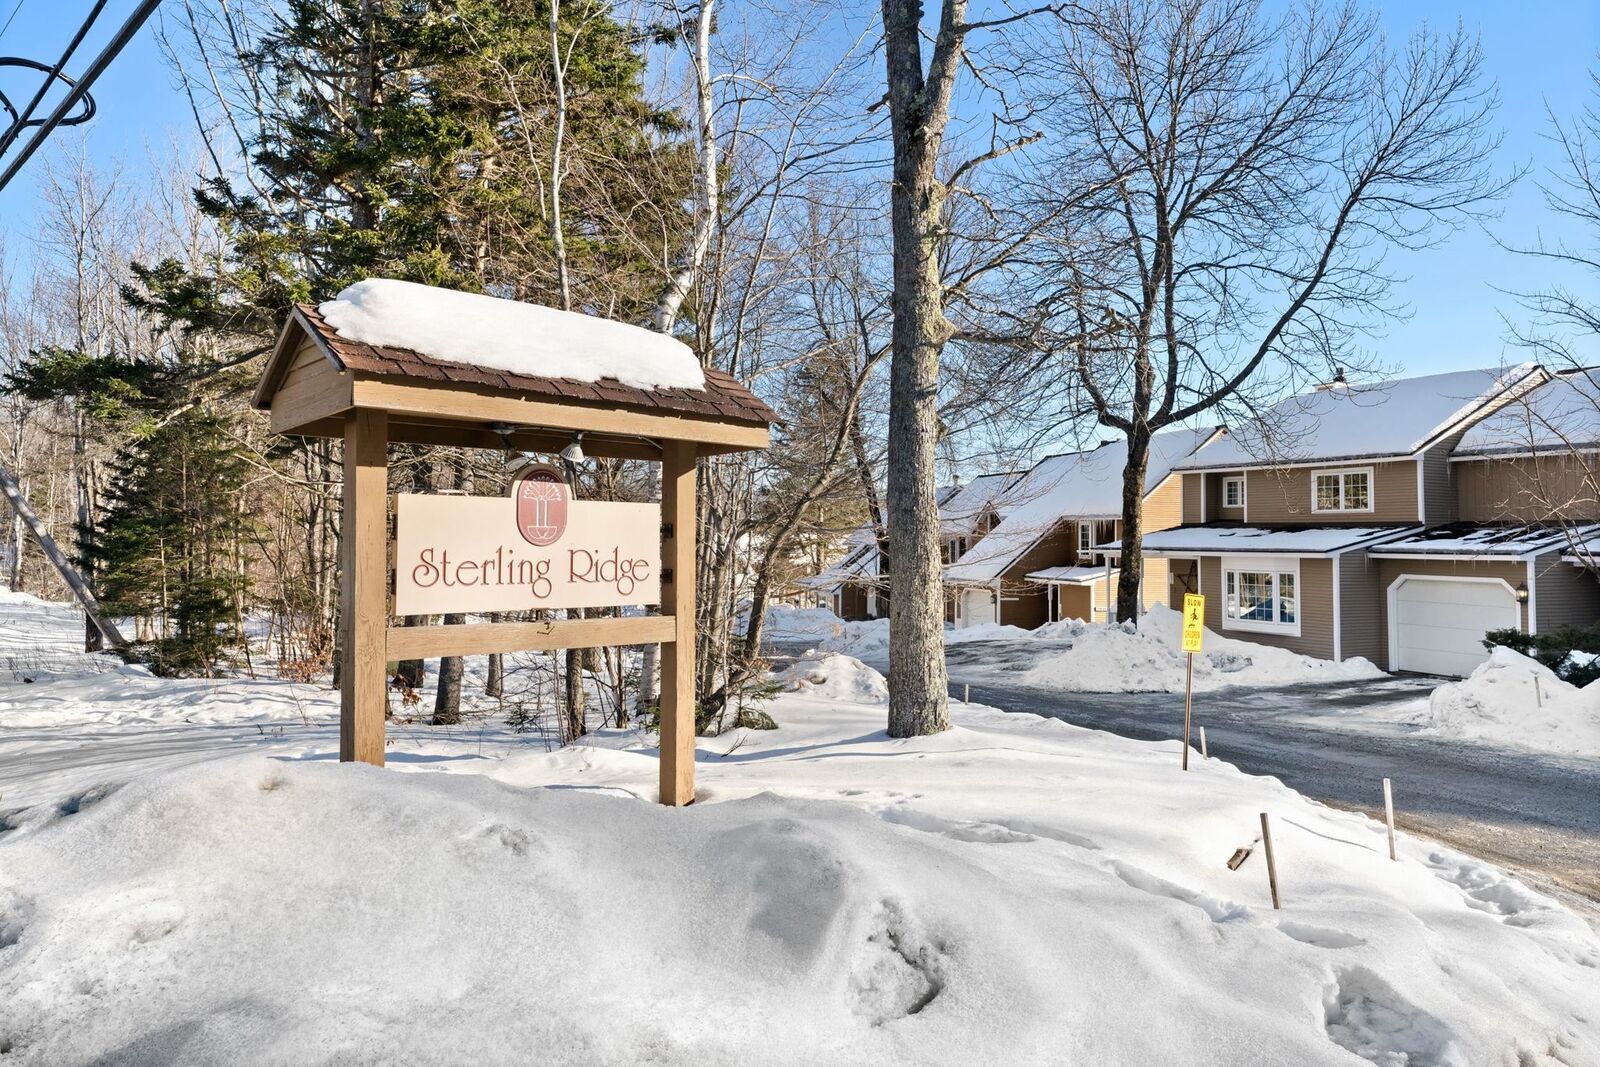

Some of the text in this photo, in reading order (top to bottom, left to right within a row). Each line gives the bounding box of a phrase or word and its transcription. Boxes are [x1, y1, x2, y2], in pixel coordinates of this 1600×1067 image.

[412, 545, 650, 598] Sterling Ridge
[1187, 598, 1201, 606] SLOW
